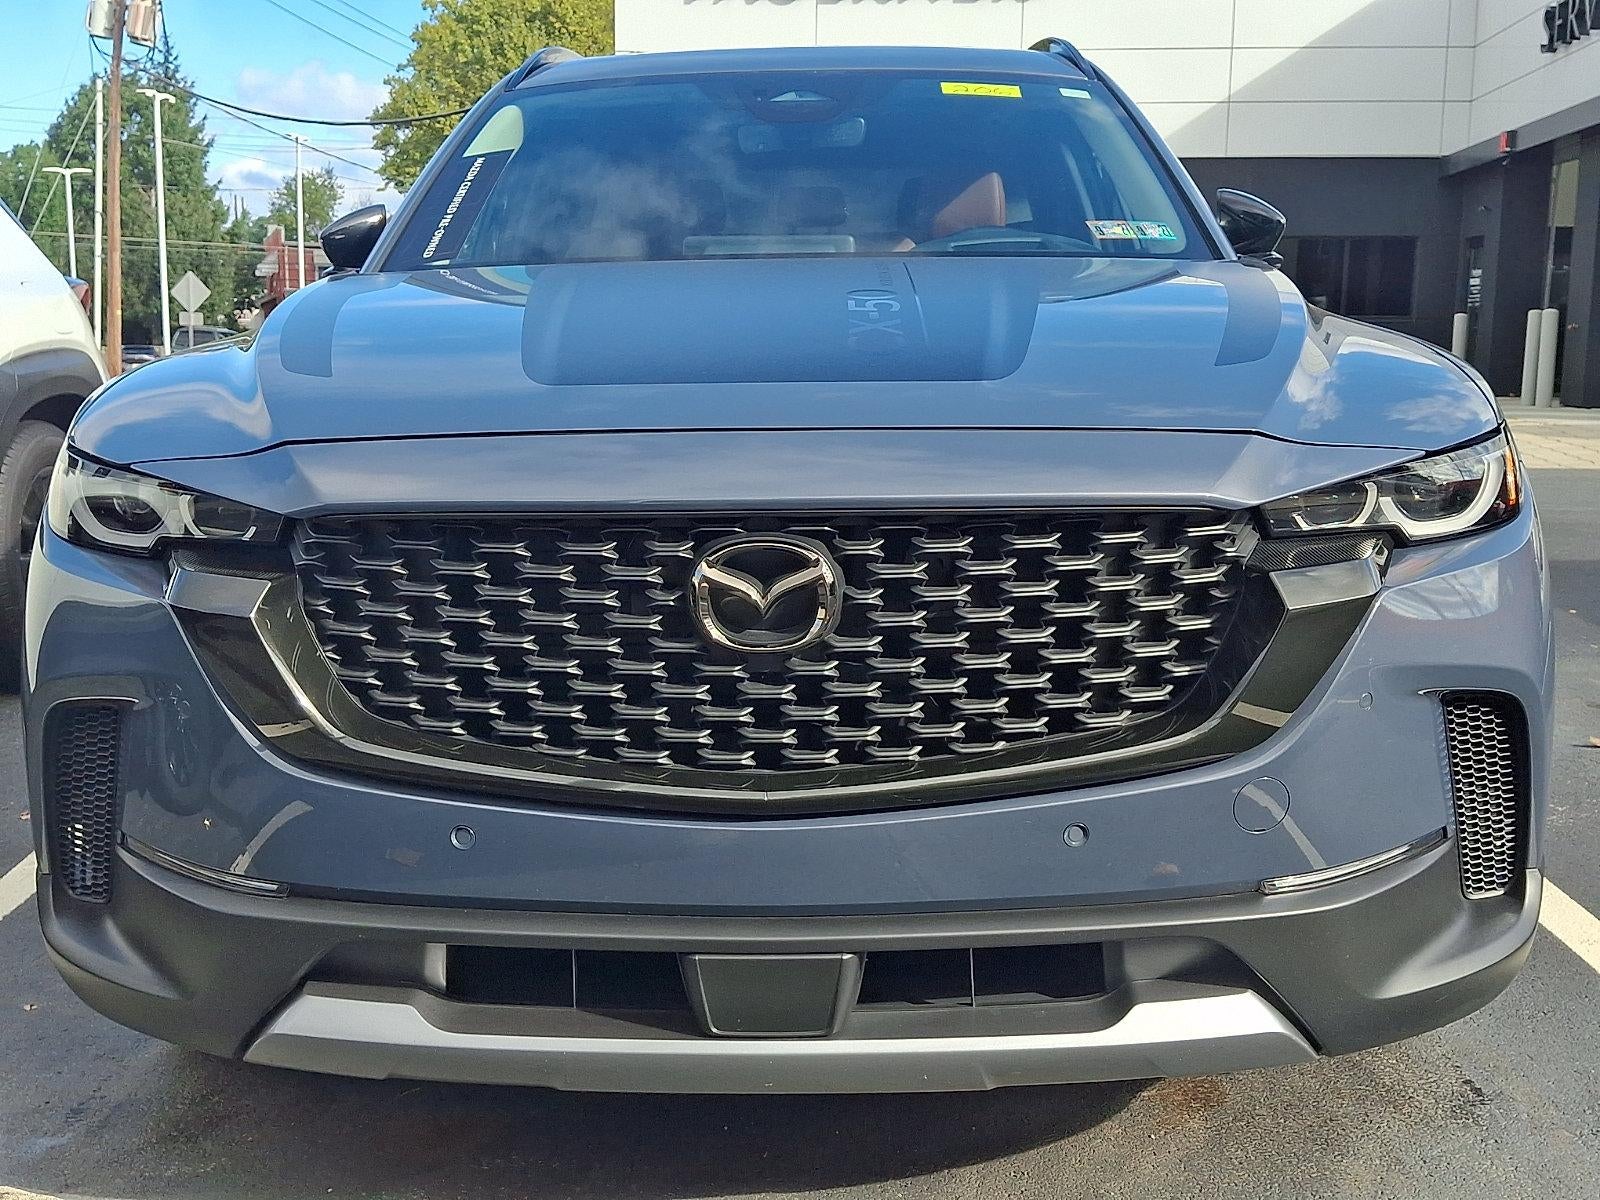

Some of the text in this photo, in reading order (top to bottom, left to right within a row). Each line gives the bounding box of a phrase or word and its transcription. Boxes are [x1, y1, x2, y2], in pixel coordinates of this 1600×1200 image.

[423, 157, 486, 258] MAZDA CERTIFIED PRE-OWNED
